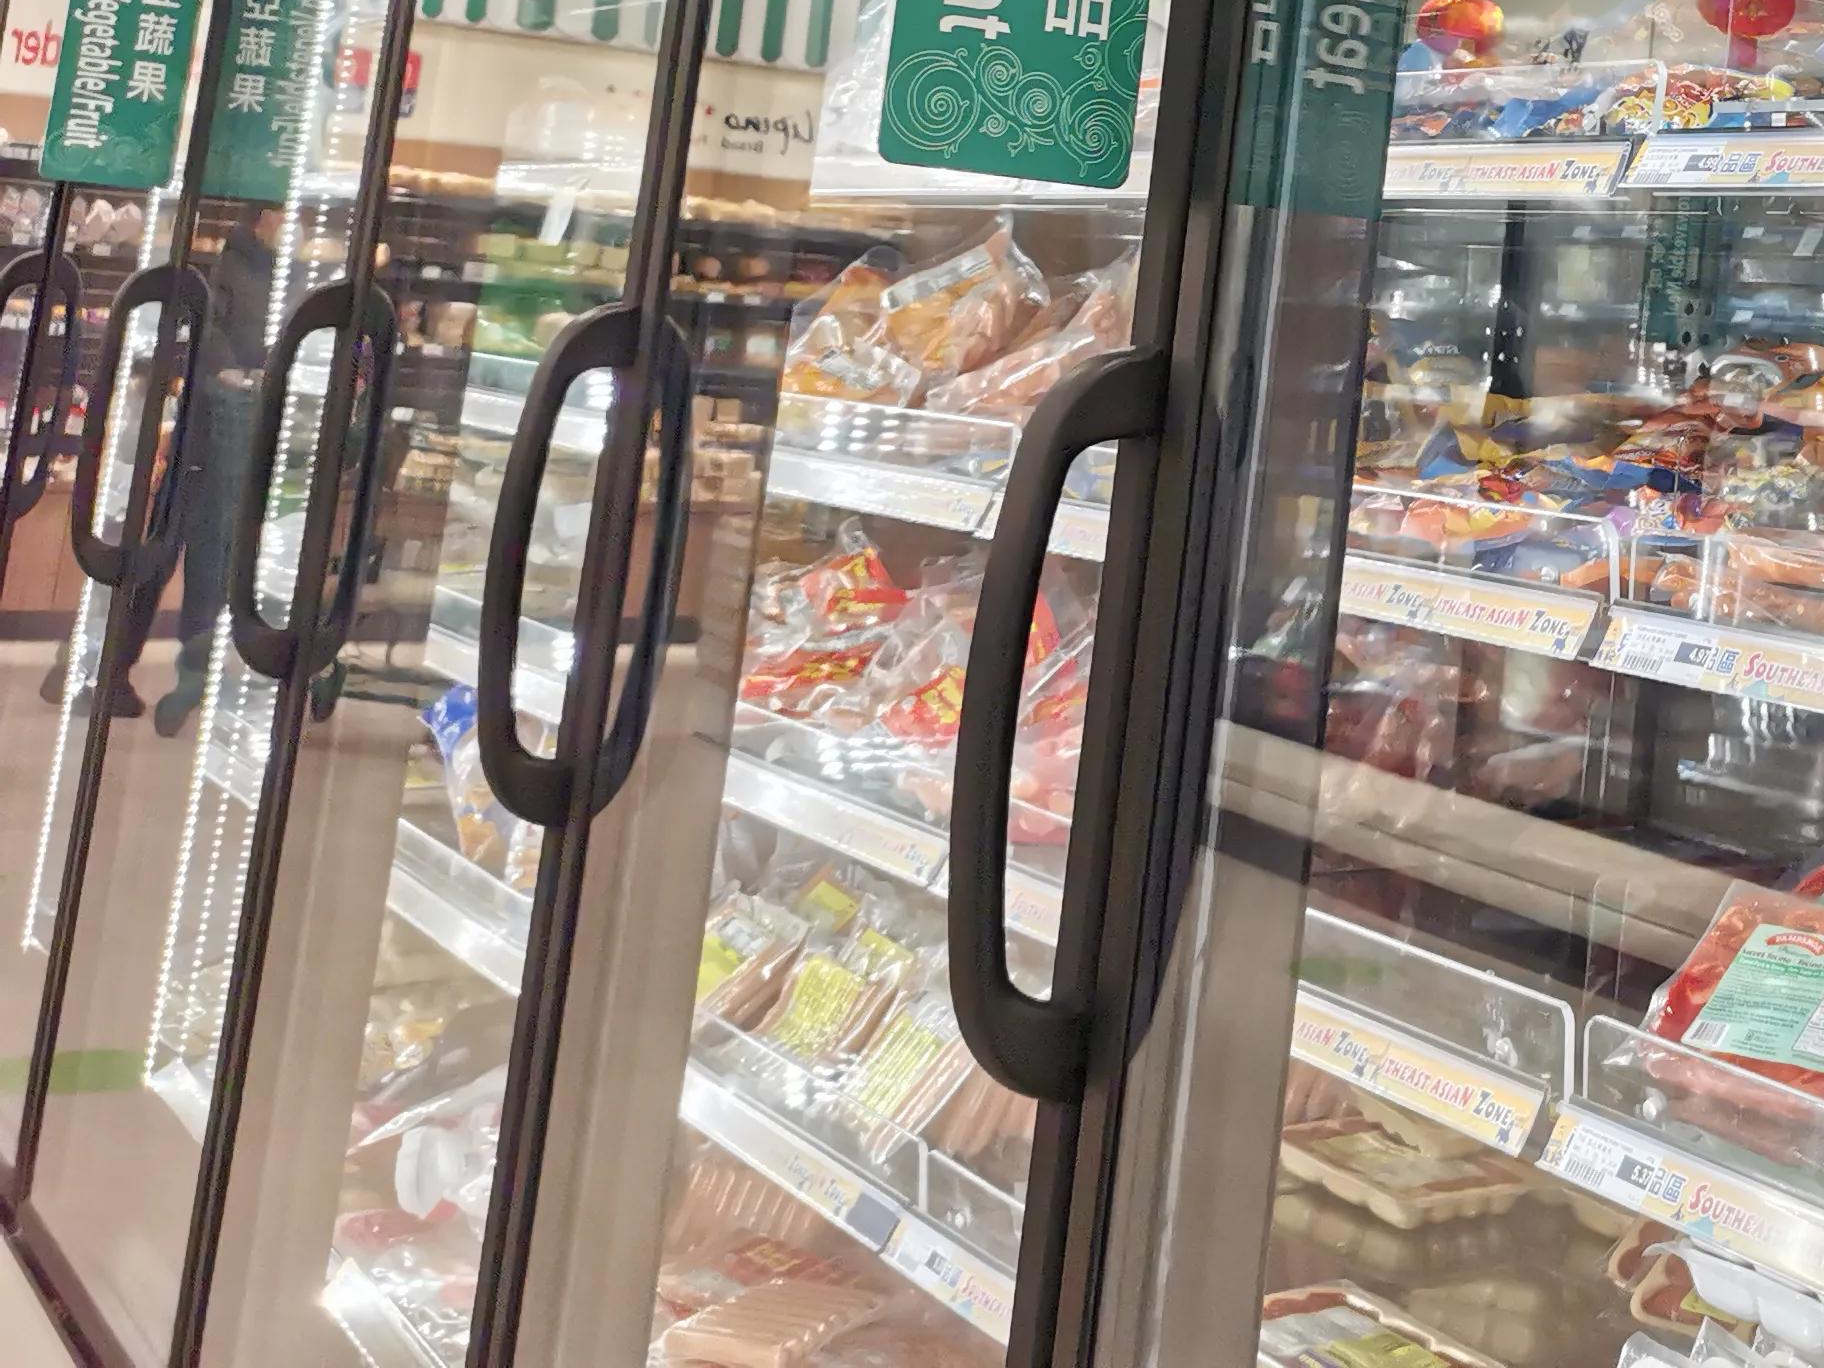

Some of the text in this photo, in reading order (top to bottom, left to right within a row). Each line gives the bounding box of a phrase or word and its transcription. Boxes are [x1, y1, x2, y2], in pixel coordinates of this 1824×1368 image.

[1516, 157, 1558, 181] ASIAN
[1560, 158, 1599, 182] ZONE
[1386, 583, 1421, 609] ZONE
[1484, 609, 1530, 630] ASIAN
[1529, 610, 1570, 637] ZONE
[1298, 1021, 1370, 1061] ASIAN ZONE
[1430, 1077, 1474, 1109] ASIAN
[1473, 1089, 1512, 1127] ZONE
